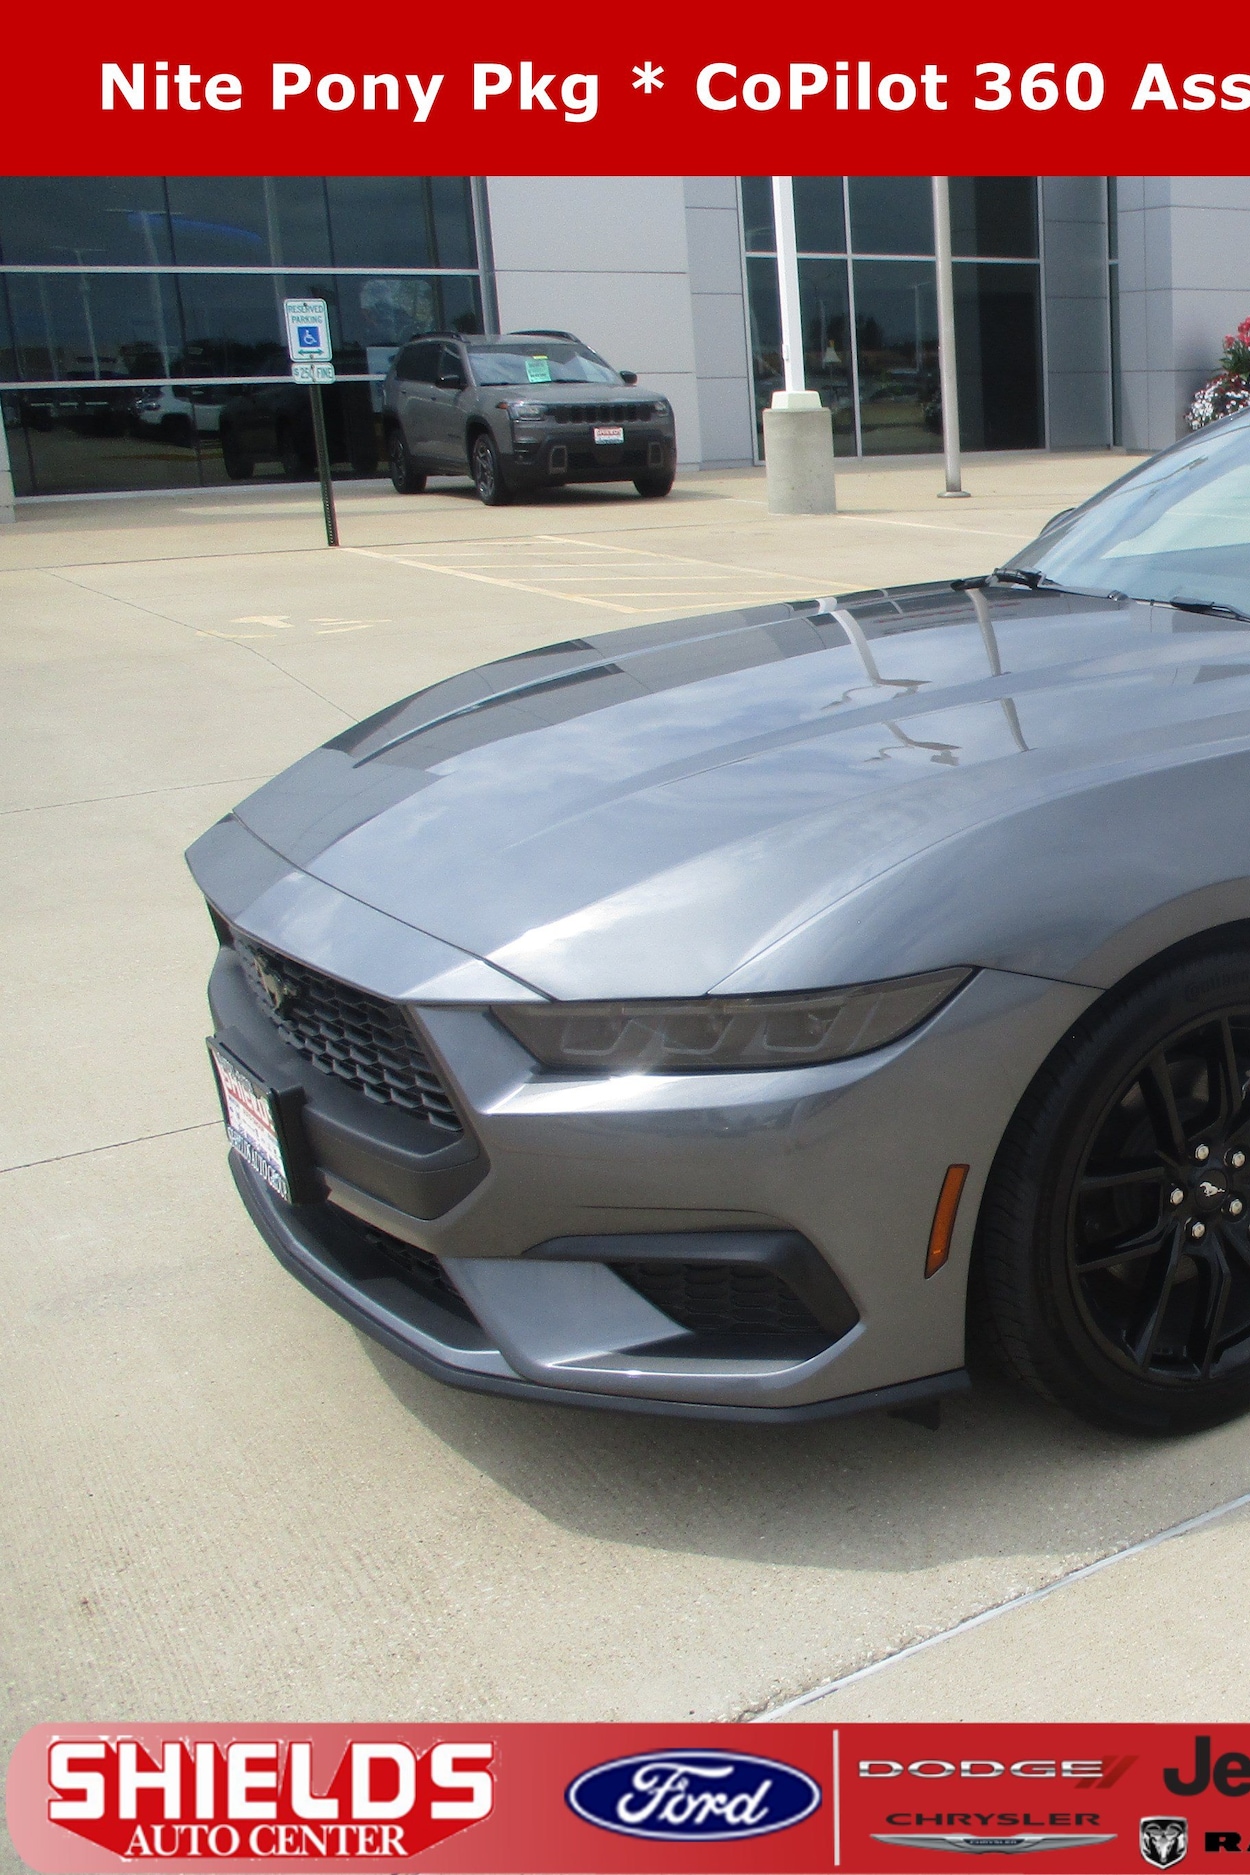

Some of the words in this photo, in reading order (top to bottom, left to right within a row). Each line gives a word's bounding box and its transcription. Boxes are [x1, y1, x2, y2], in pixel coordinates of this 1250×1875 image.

[287, 305, 324, 313] RESERVED
[291, 315, 323, 324] PARKING
[317, 367, 333, 378] FINE
